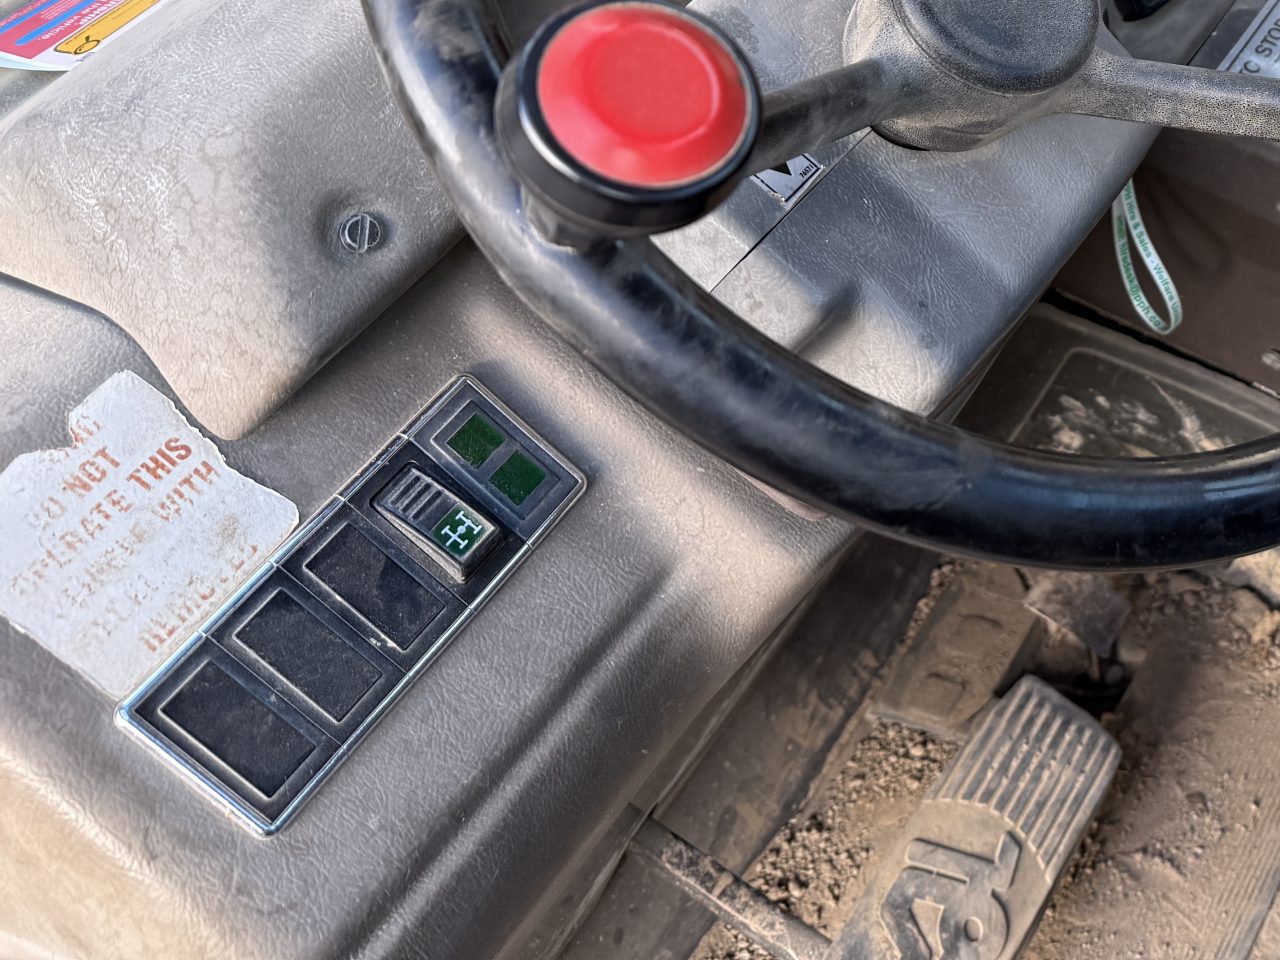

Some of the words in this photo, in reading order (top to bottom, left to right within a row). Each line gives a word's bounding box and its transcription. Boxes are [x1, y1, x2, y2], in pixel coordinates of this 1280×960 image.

[1126, 201, 1136, 221] Hire
[1132, 222, 1140, 231] &
[1136, 230, 1152, 258] Sales
[1153, 263, 1175, 301] Welfare
[62, 445, 121, 499] NOT
[126, 436, 193, 491] THIS
[151, 459, 222, 522] WITH
